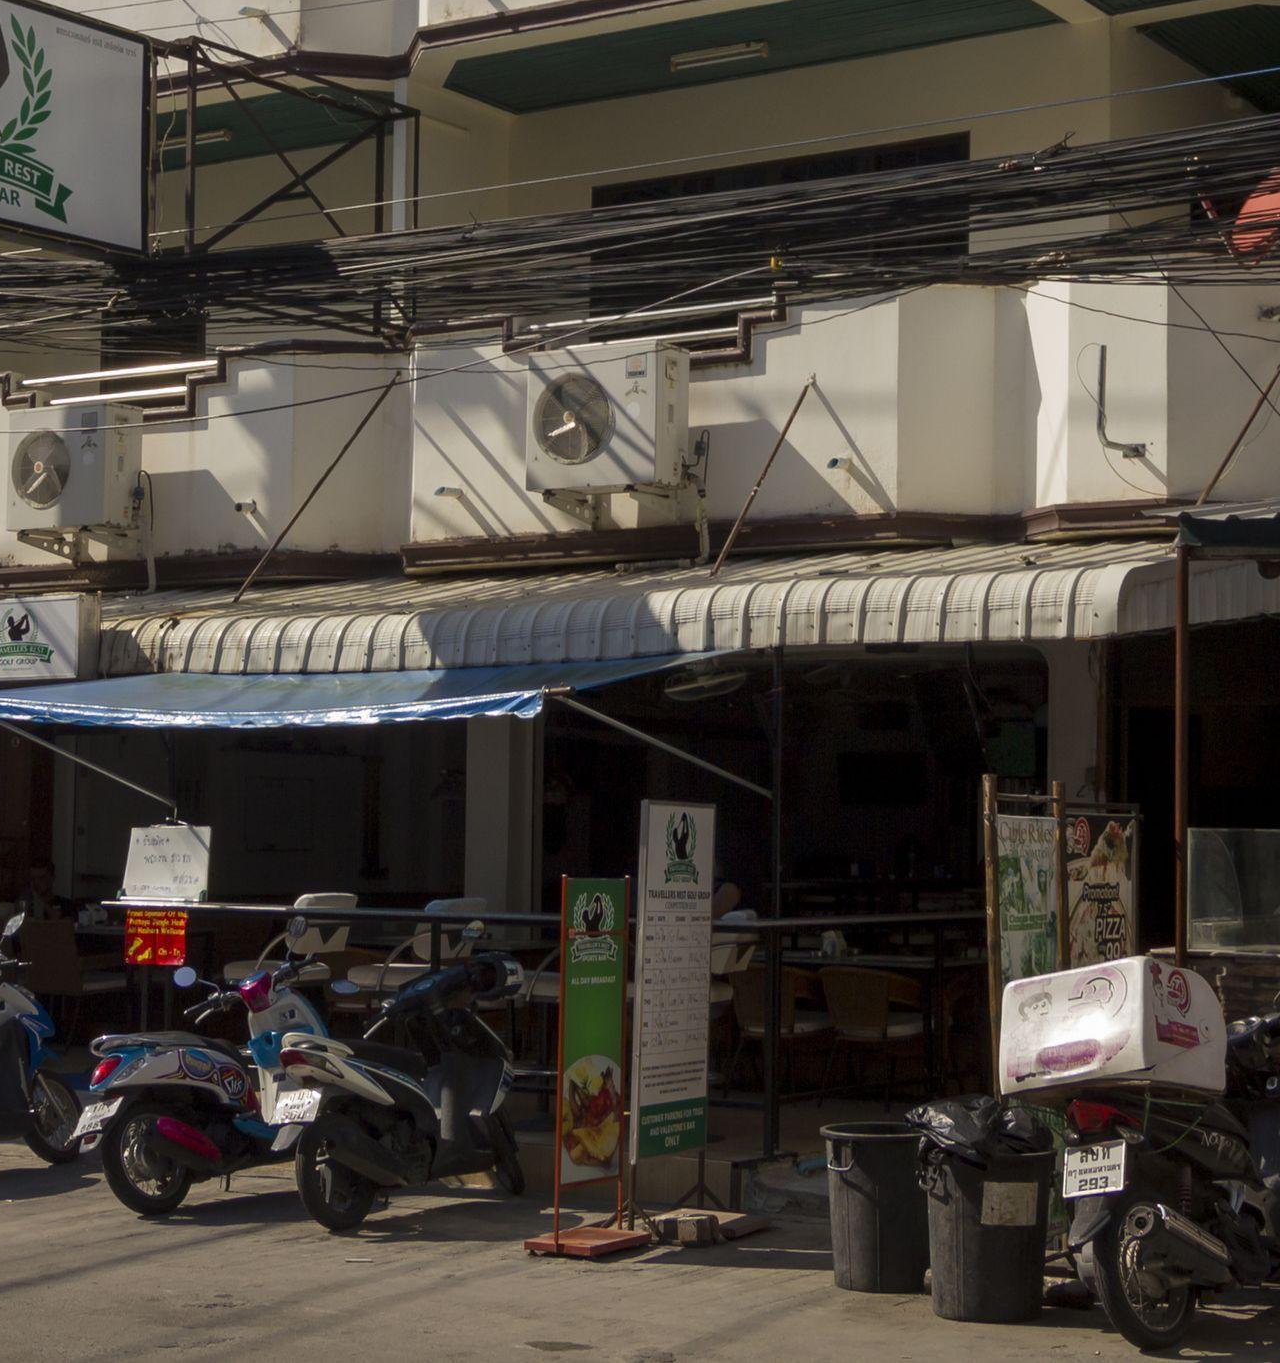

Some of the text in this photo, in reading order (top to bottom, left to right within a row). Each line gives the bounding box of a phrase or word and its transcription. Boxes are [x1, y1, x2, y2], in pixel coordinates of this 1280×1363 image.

[5, 160, 40, 185] REST
[1083, 884, 1119, 900] Promotion!
[1096, 917, 1125, 939] PIZZA
[665, 1135, 680, 1149] ONLY
[1079, 1176, 1109, 1191] 293
